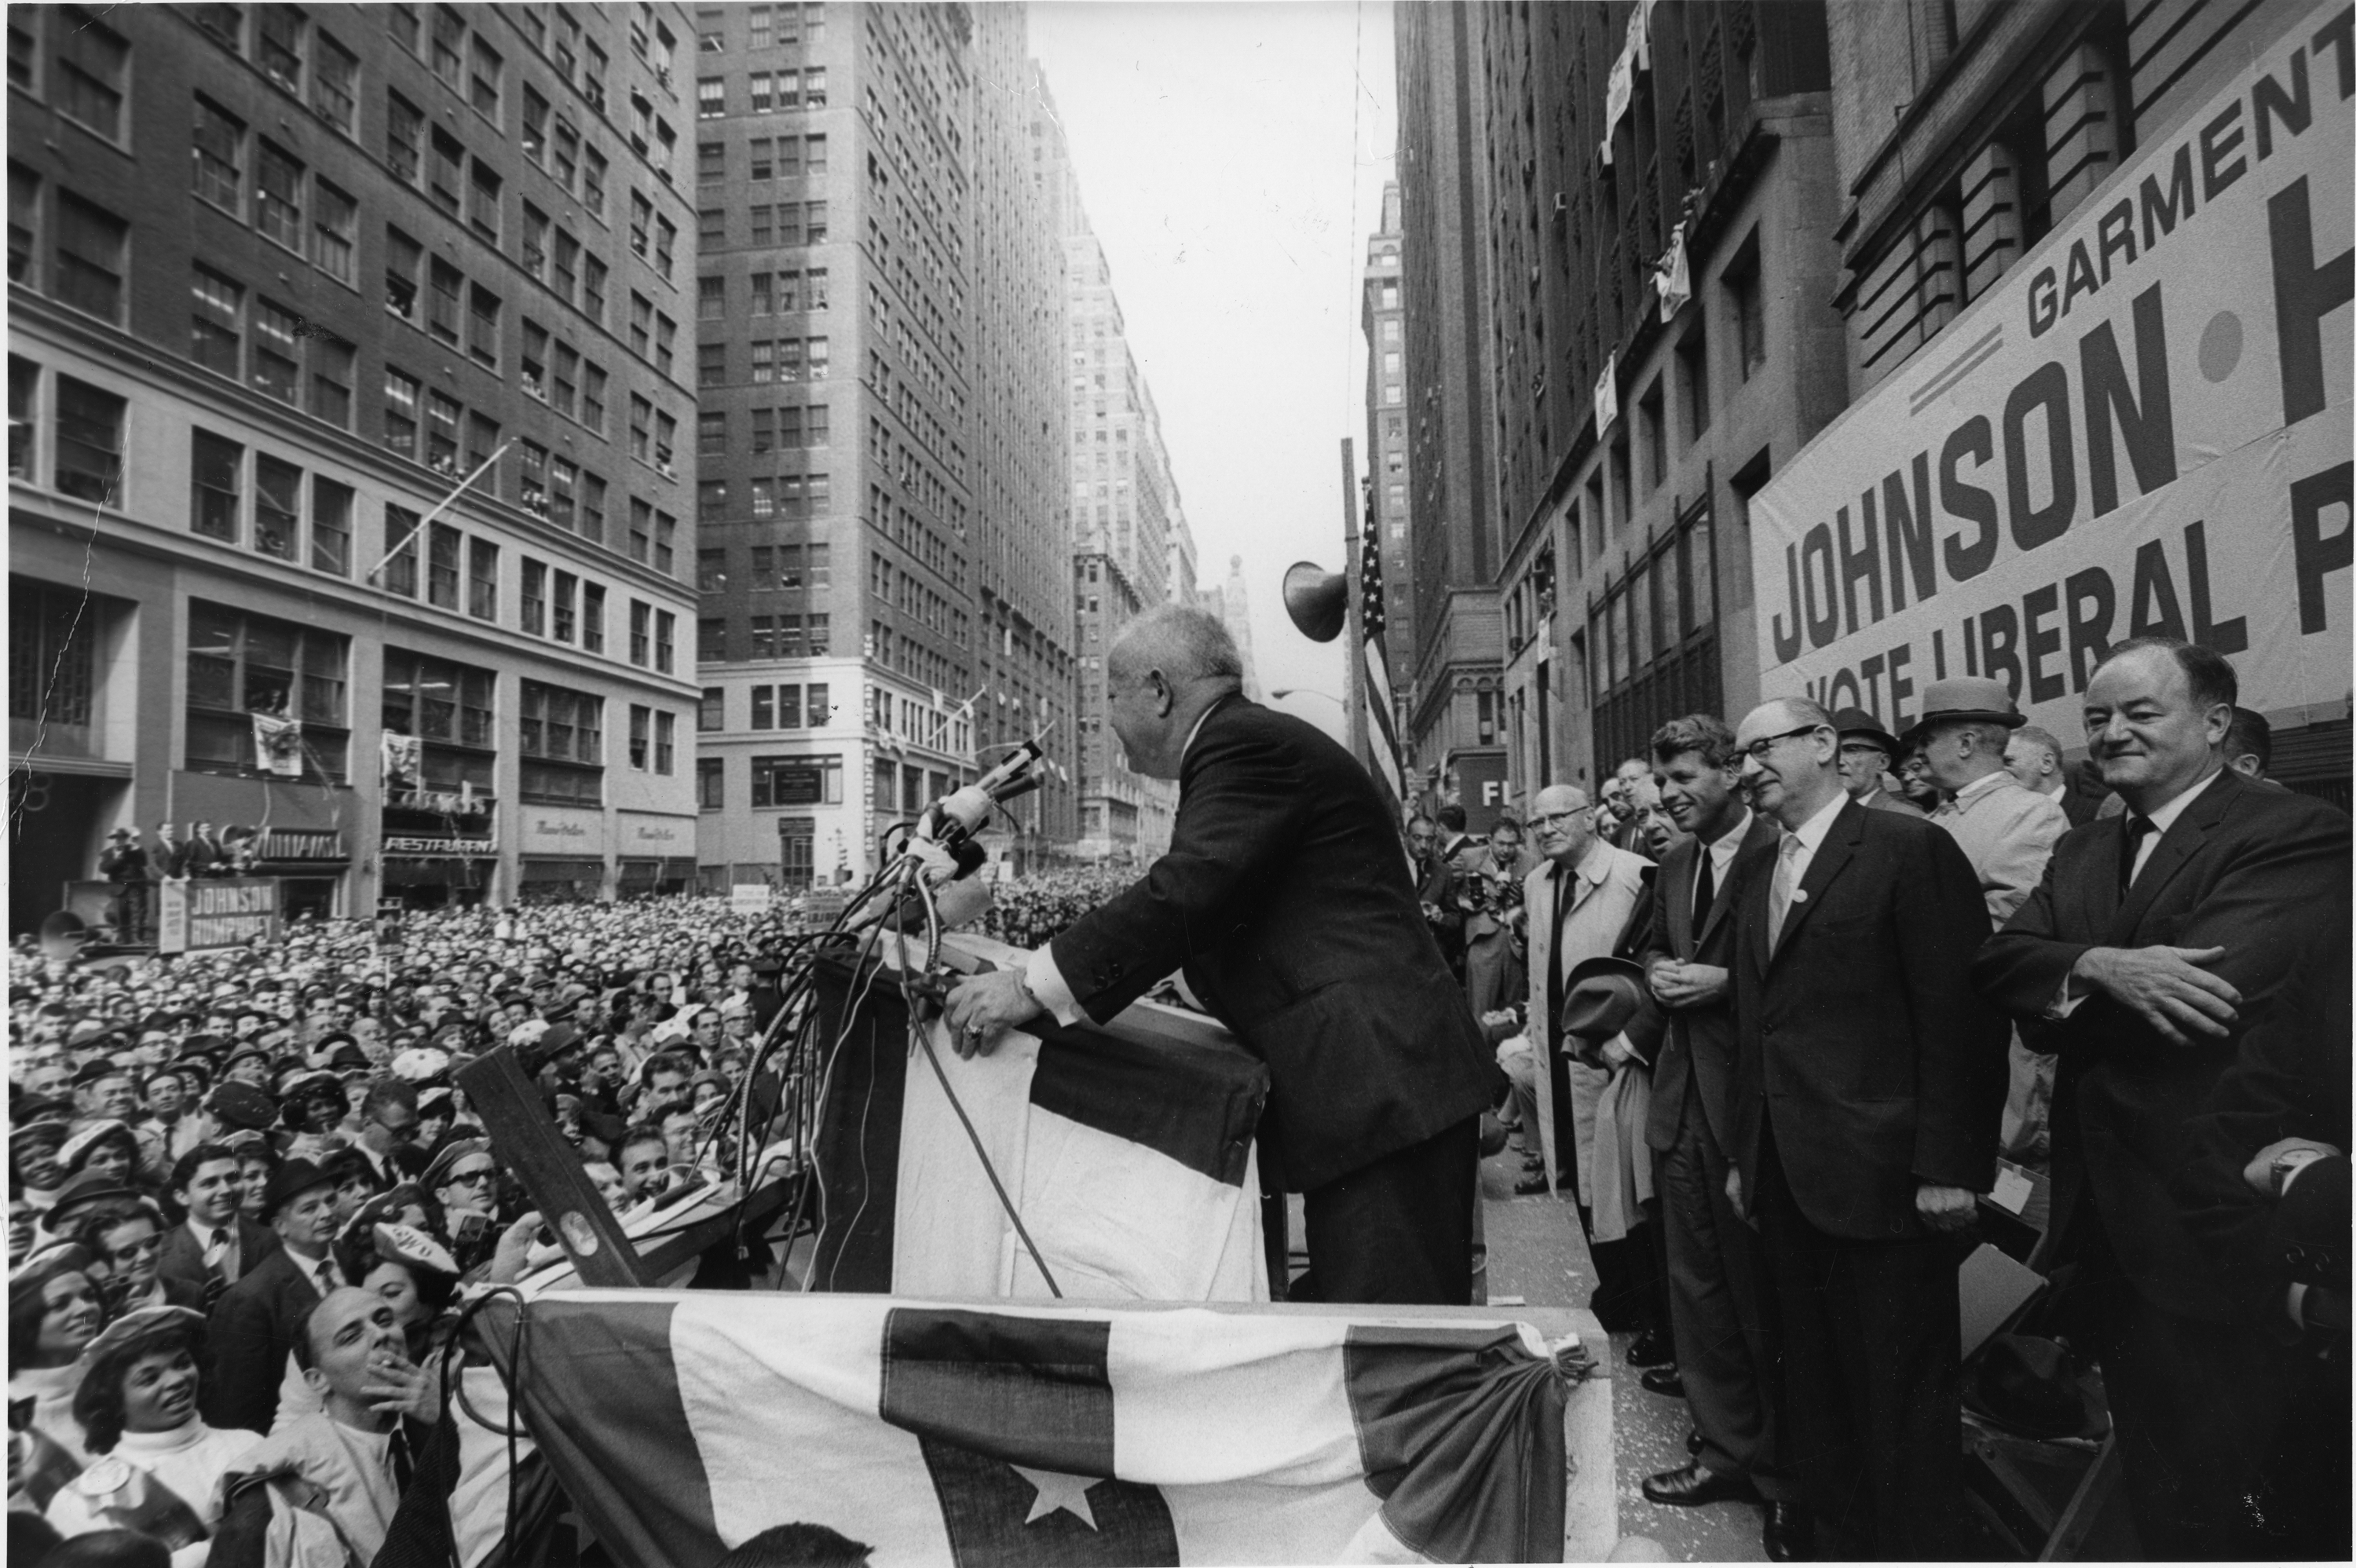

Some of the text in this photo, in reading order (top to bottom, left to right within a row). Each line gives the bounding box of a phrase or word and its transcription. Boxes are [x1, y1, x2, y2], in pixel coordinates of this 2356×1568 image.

[2029, 2, 2354, 338] GARMENT
[1772, 280, 2178, 663] JOHNSON
[2290, 460, 2354, 635] P
[191, 886, 273, 916] JOHNSON
[385, 837, 498, 853] RESTAURANT
